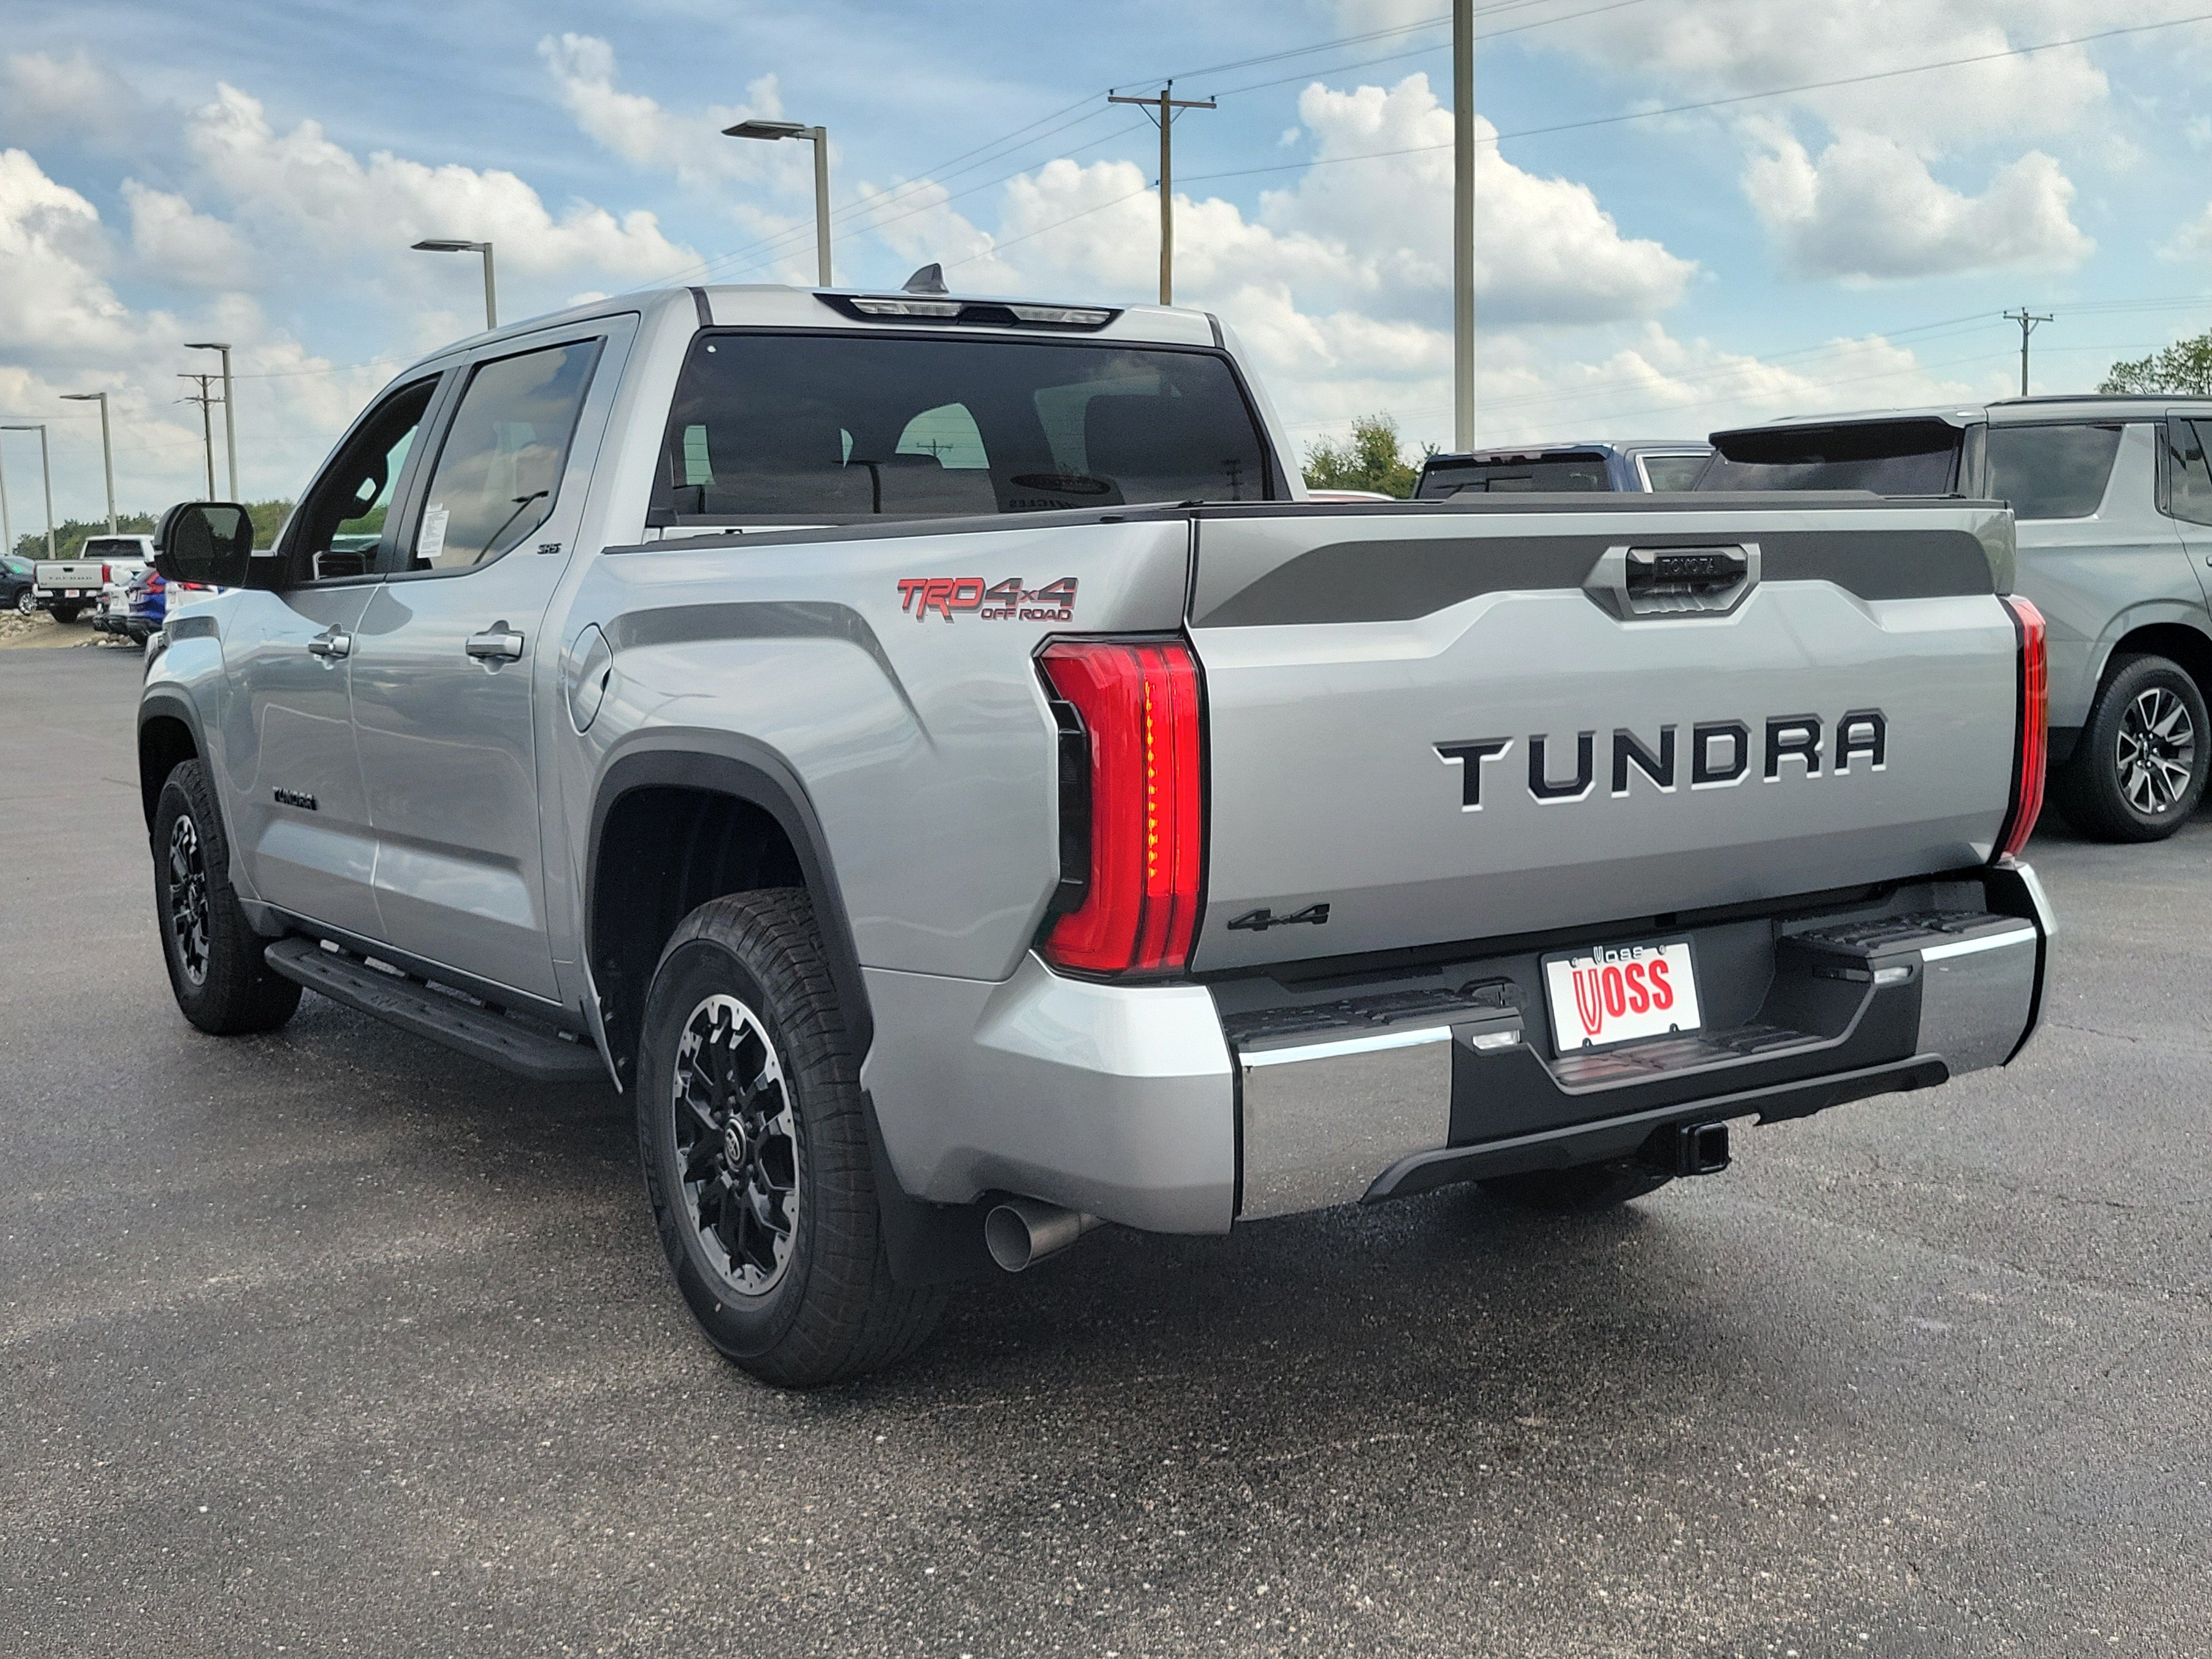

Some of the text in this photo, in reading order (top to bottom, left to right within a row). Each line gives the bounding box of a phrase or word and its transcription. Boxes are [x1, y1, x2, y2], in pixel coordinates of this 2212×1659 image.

[981, 608, 1074, 622] OFF ROAD
[1432, 708, 1888, 812] TUNDRA
[1572, 959, 1674, 1036] VOSS
